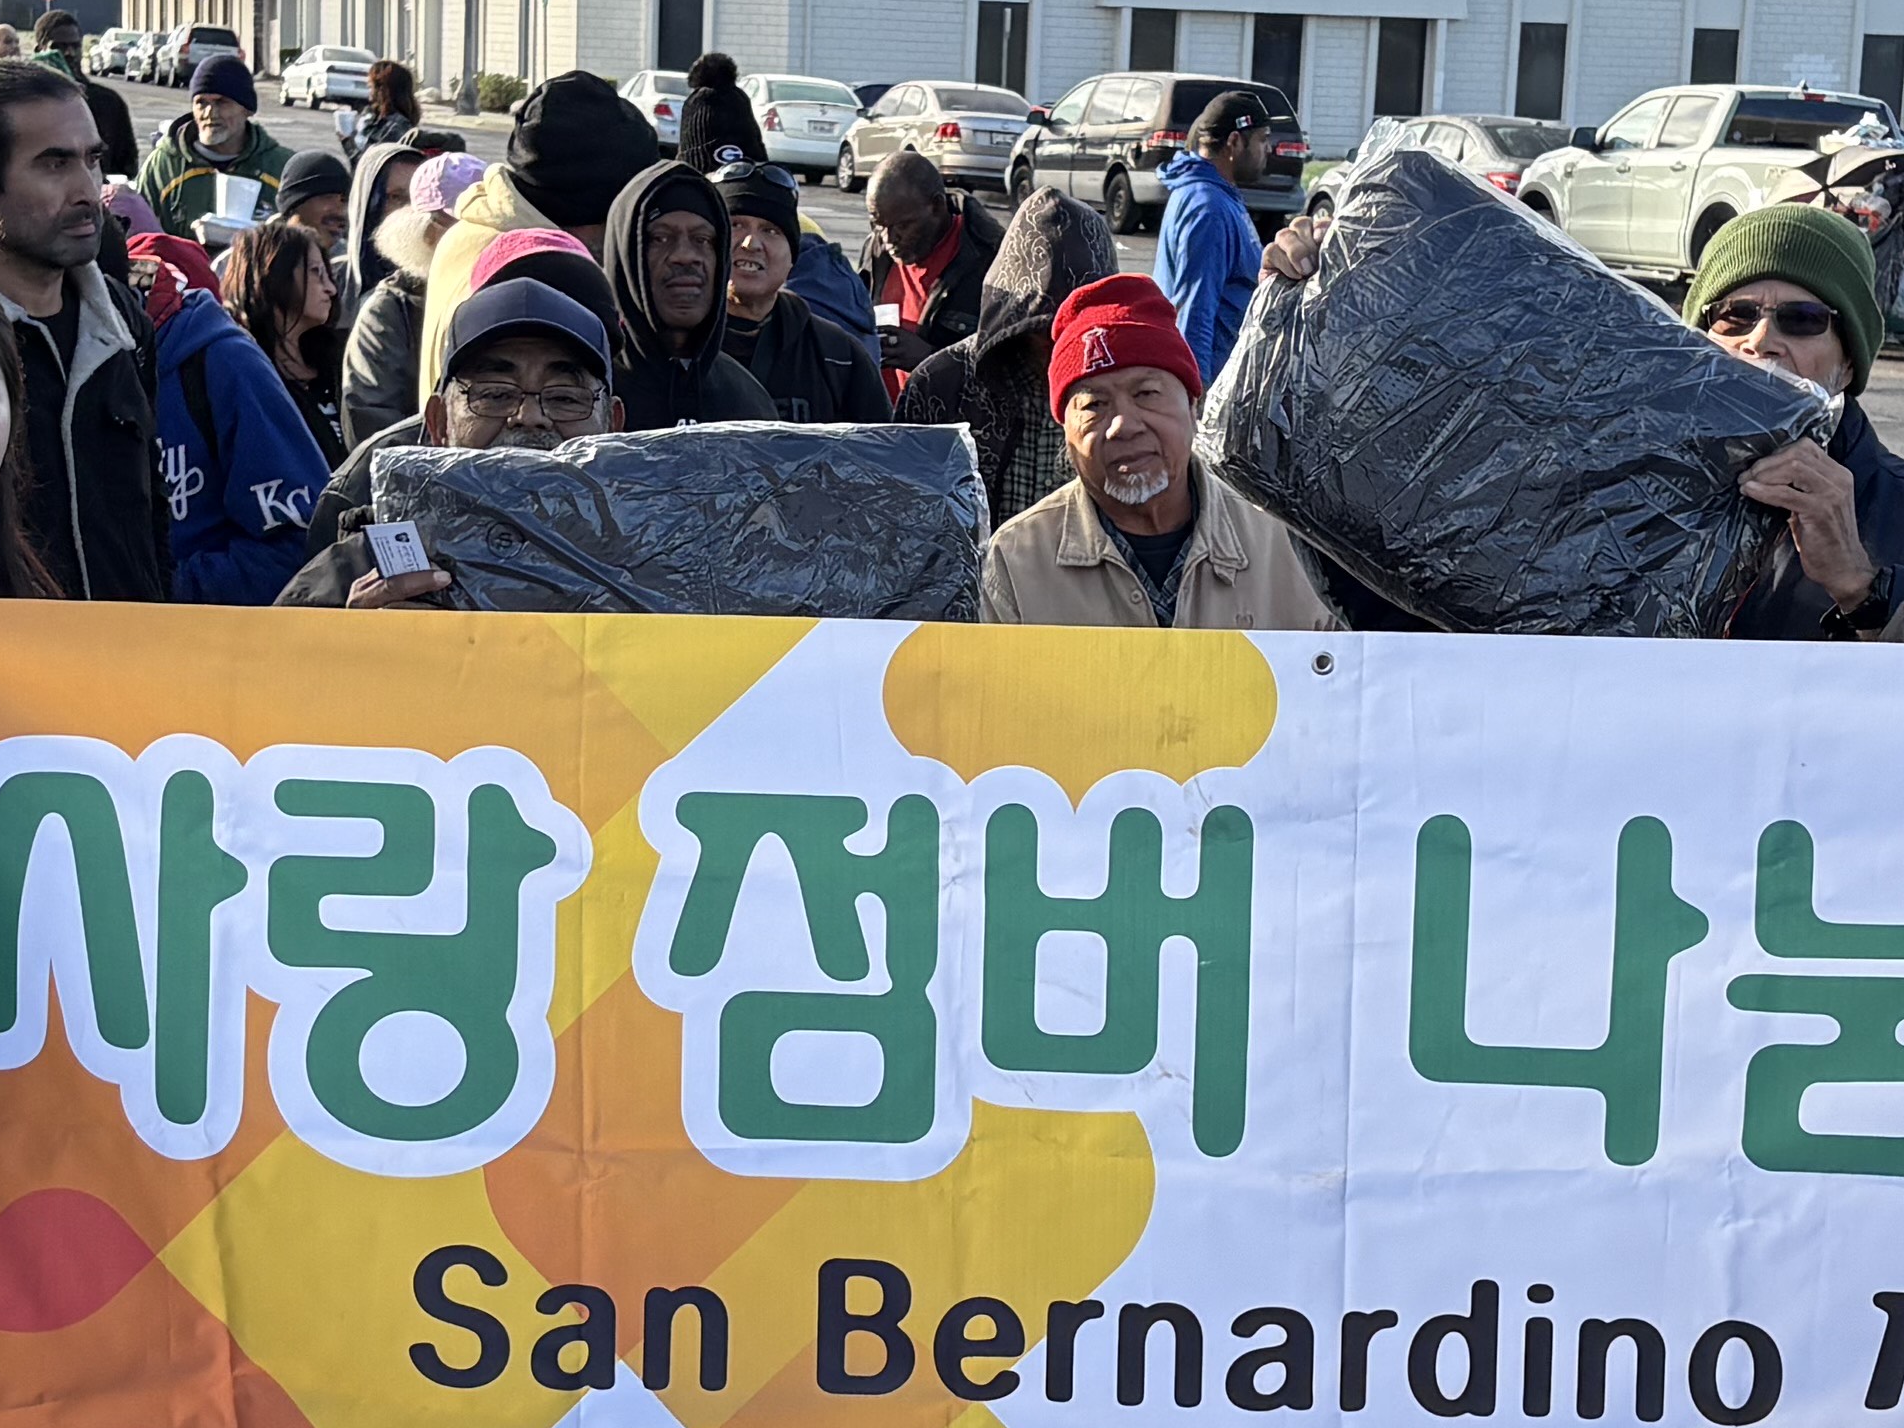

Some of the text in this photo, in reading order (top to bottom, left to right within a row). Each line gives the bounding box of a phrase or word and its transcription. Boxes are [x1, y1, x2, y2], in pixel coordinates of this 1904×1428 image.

[1081, 326, 1115, 374] A
[669, 792, 1255, 1159] 점버
[408, 1244, 730, 1393] San
[815, 1257, 1784, 1428] Bernardino
